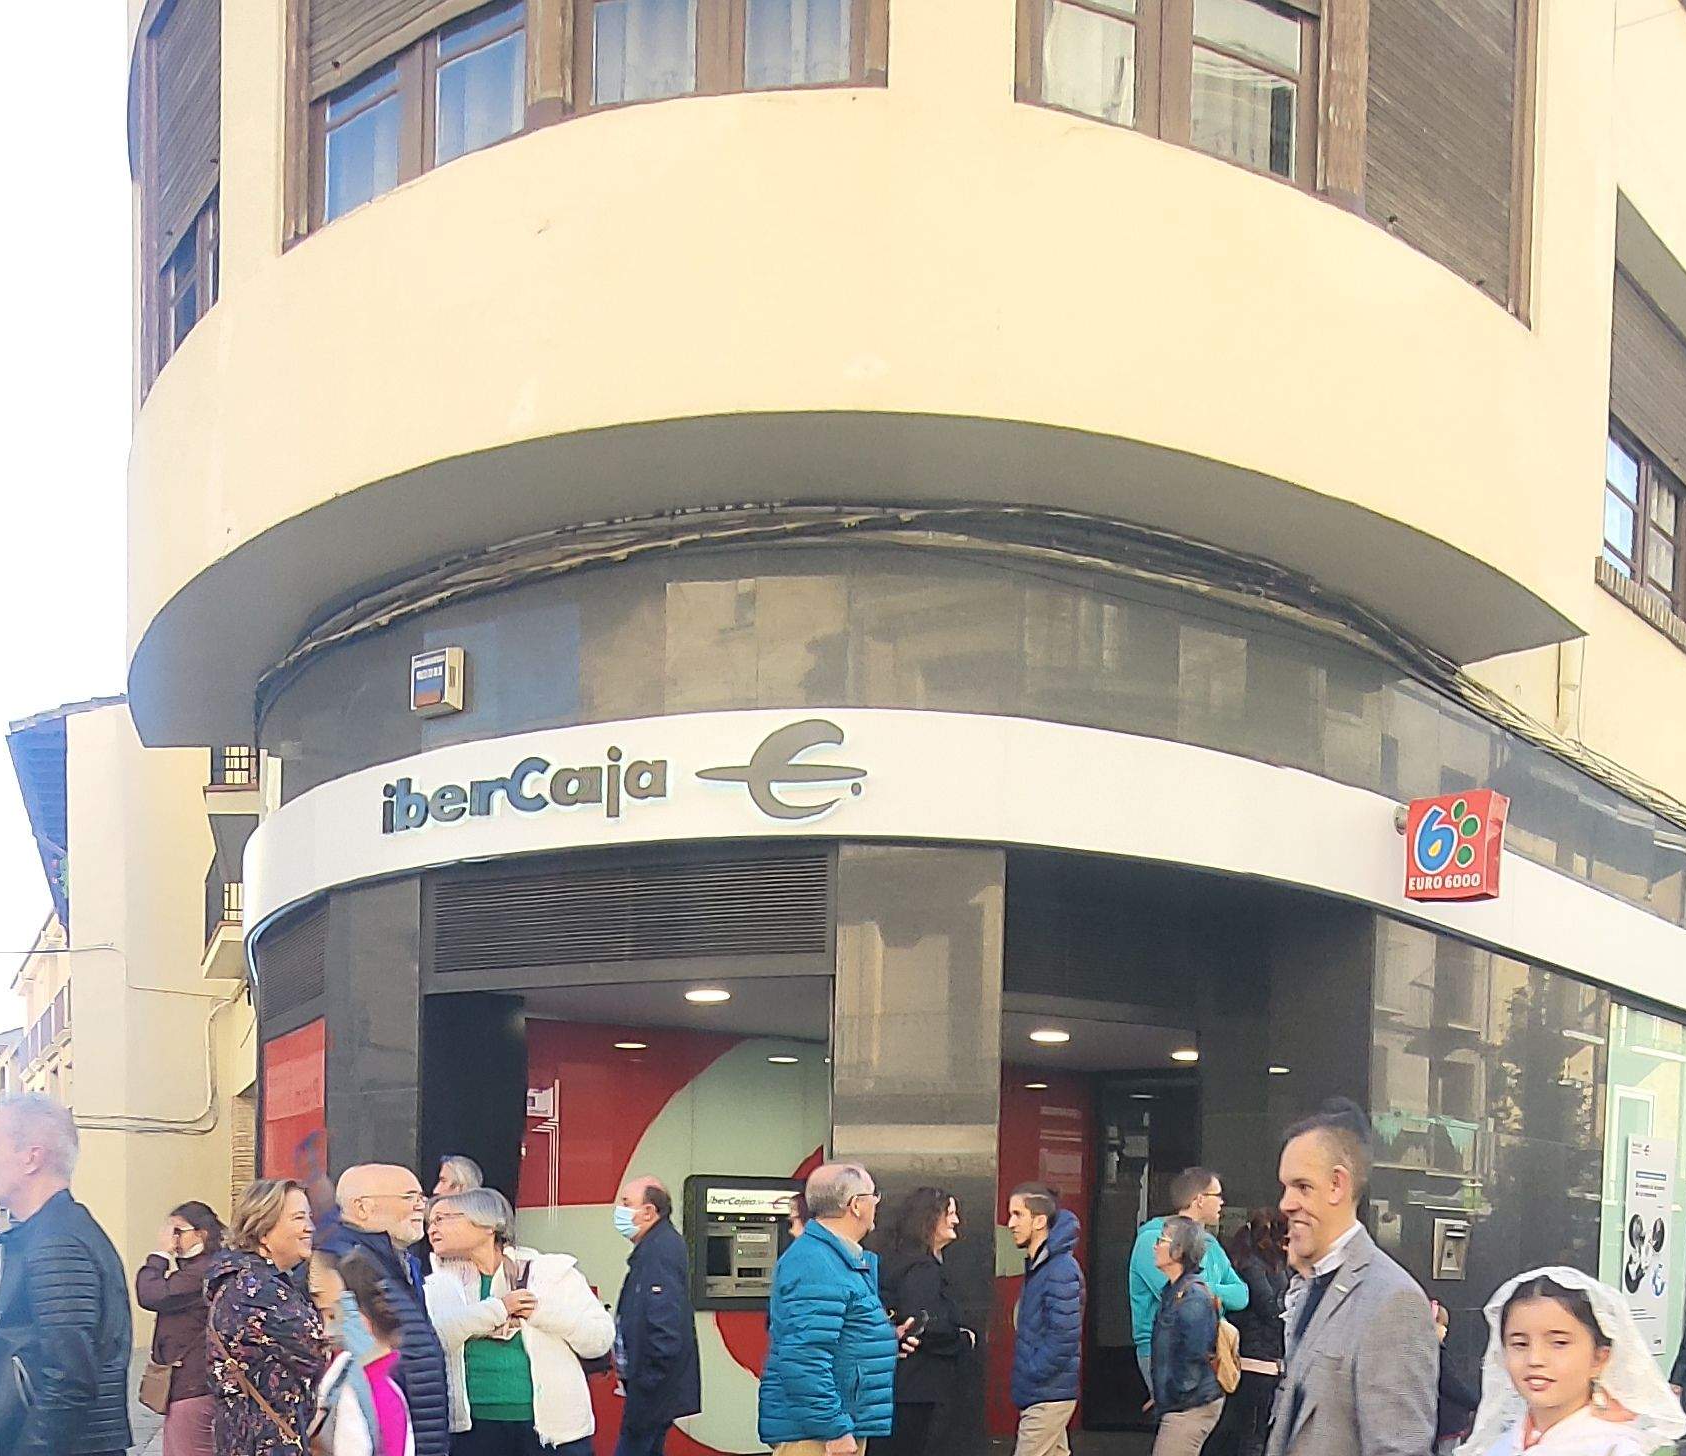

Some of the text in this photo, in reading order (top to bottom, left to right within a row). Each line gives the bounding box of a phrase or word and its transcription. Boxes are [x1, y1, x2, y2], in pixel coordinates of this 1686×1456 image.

[381, 745, 667, 834] iberCaja
[1408, 873, 1481, 891] EURO 6000
